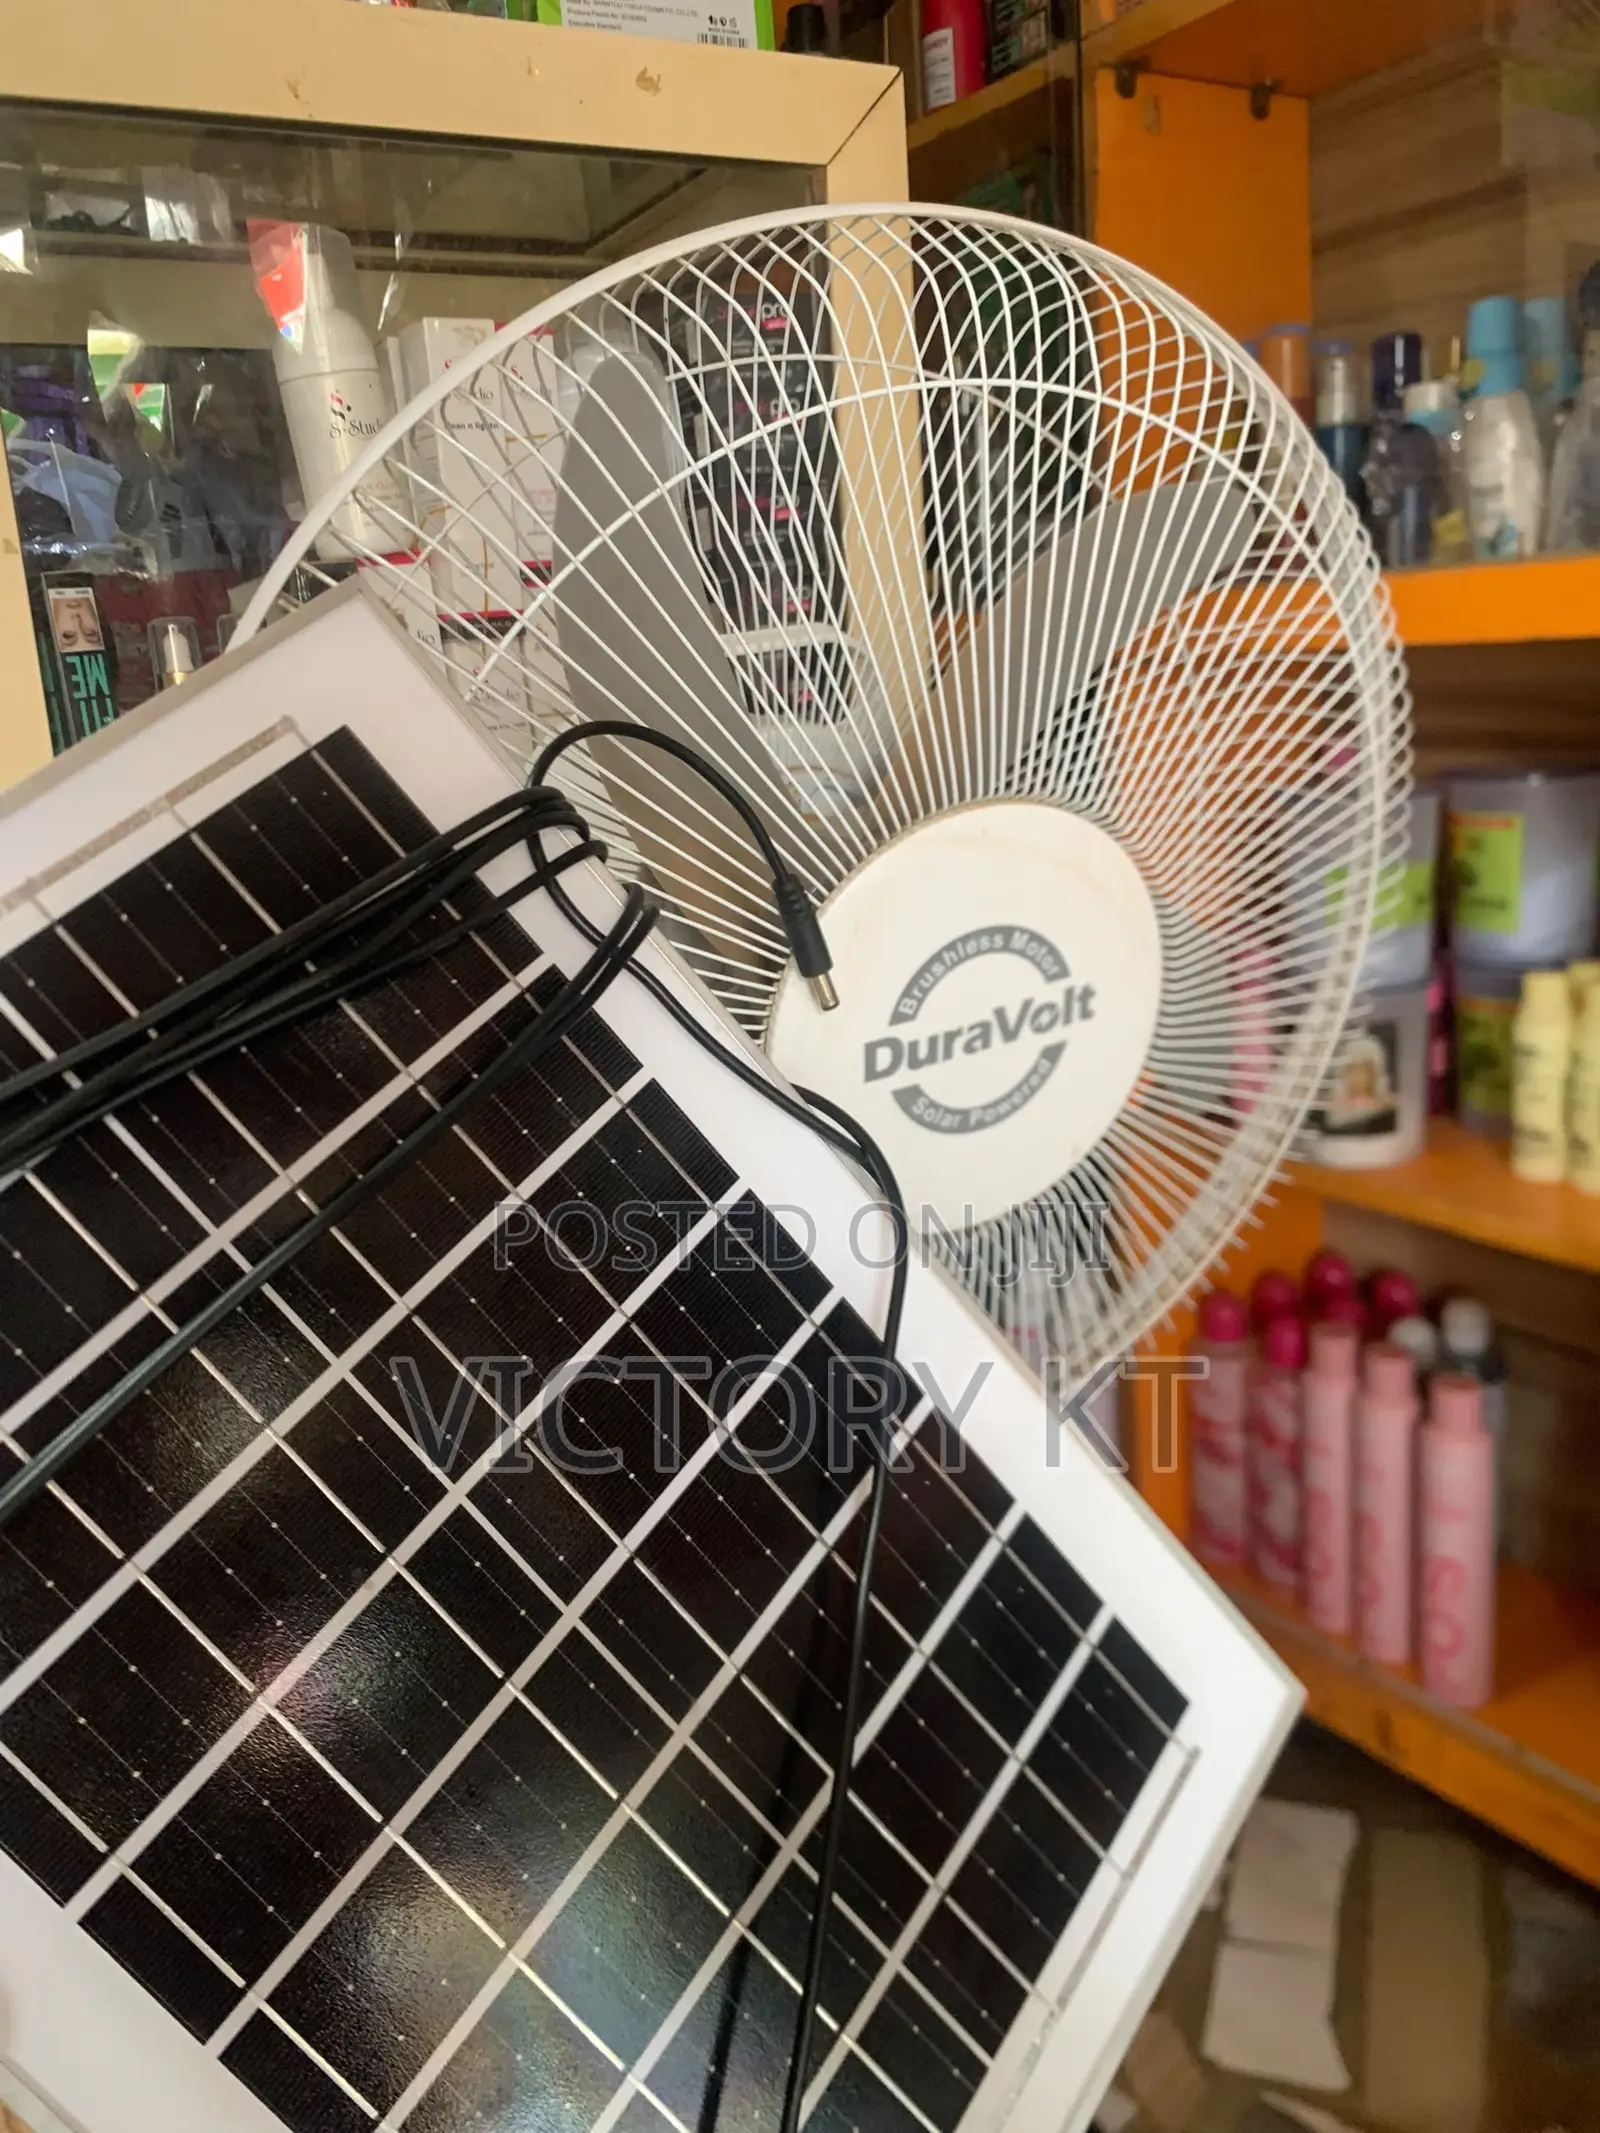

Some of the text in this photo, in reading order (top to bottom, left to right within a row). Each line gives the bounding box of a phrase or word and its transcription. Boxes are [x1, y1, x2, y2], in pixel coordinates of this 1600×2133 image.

[65, 654, 111, 699] ME
[898, 930, 1060, 1016] Brushless Motor
[863, 983, 1096, 1083] DuraVolt
[911, 1058, 1053, 1129] Solar Powered
